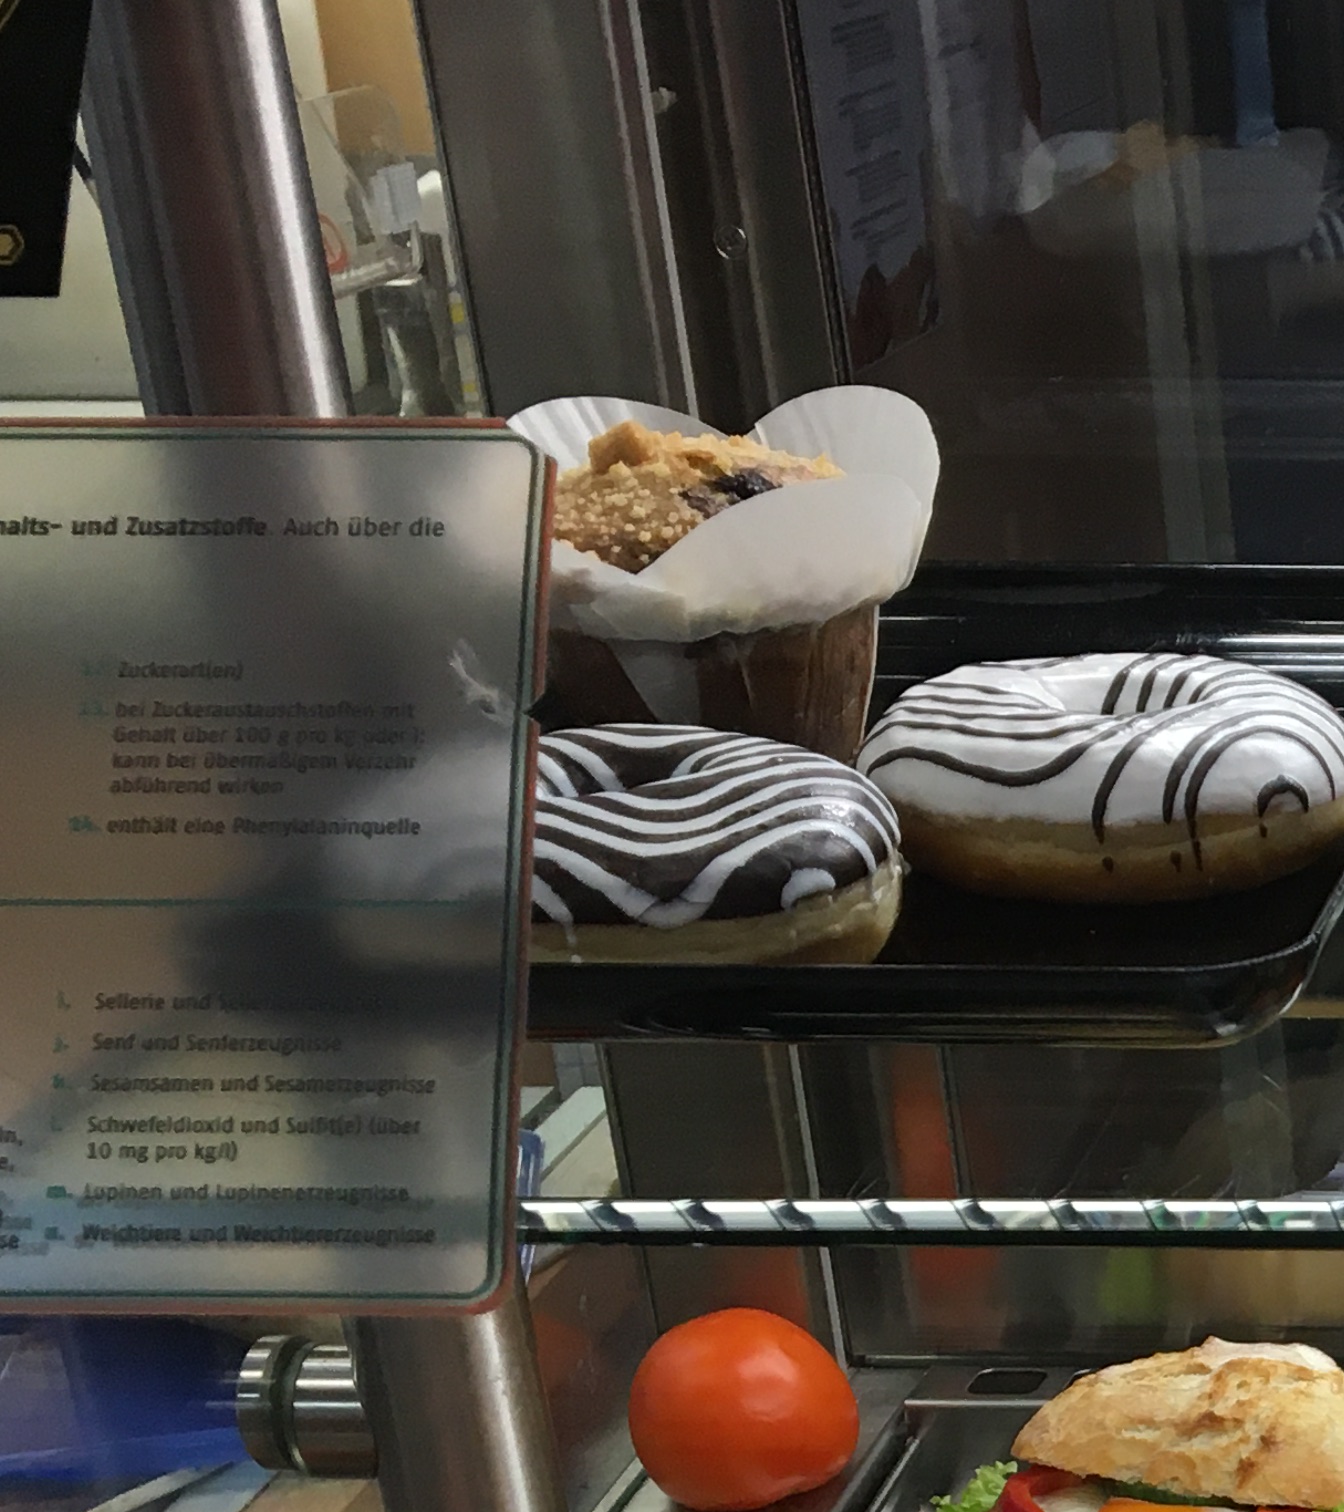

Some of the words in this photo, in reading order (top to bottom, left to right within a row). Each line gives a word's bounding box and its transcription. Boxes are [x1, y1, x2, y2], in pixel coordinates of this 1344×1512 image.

[71, 515, 118, 537] und
[284, 517, 339, 537] Auch
[348, 515, 401, 538] über
[409, 516, 445, 537] die
[182, 726, 228, 743] über
[112, 754, 160, 770] kann
[166, 753, 197, 770] bei
[110, 777, 211, 794] abführend
[107, 816, 177, 834] enthält
[184, 818, 225, 834] eine
[94, 992, 165, 1011] Sellerie
[172, 992, 211, 1010] und
[92, 1032, 136, 1051] Senf
[141, 1034, 180, 1051] und
[91, 1073, 214, 1092] Sesamsamen
[220, 1075, 259, 1092] und
[87, 1115, 235, 1134] Schwefeldioxid
[241, 1117, 280, 1134] und
[286, 1116, 361, 1136] Sulfit(e)
[369, 1116, 421, 1135] (über
[87, 1142, 113, 1160] 10
[118, 1144, 150, 1163] mg
[155, 1144, 188, 1163] pro
[194, 1140, 238, 1163] kg/l)
[84, 1182, 162, 1202] Lupinen
[169, 1183, 208, 1200] und
[189, 1225, 228, 1242] und
